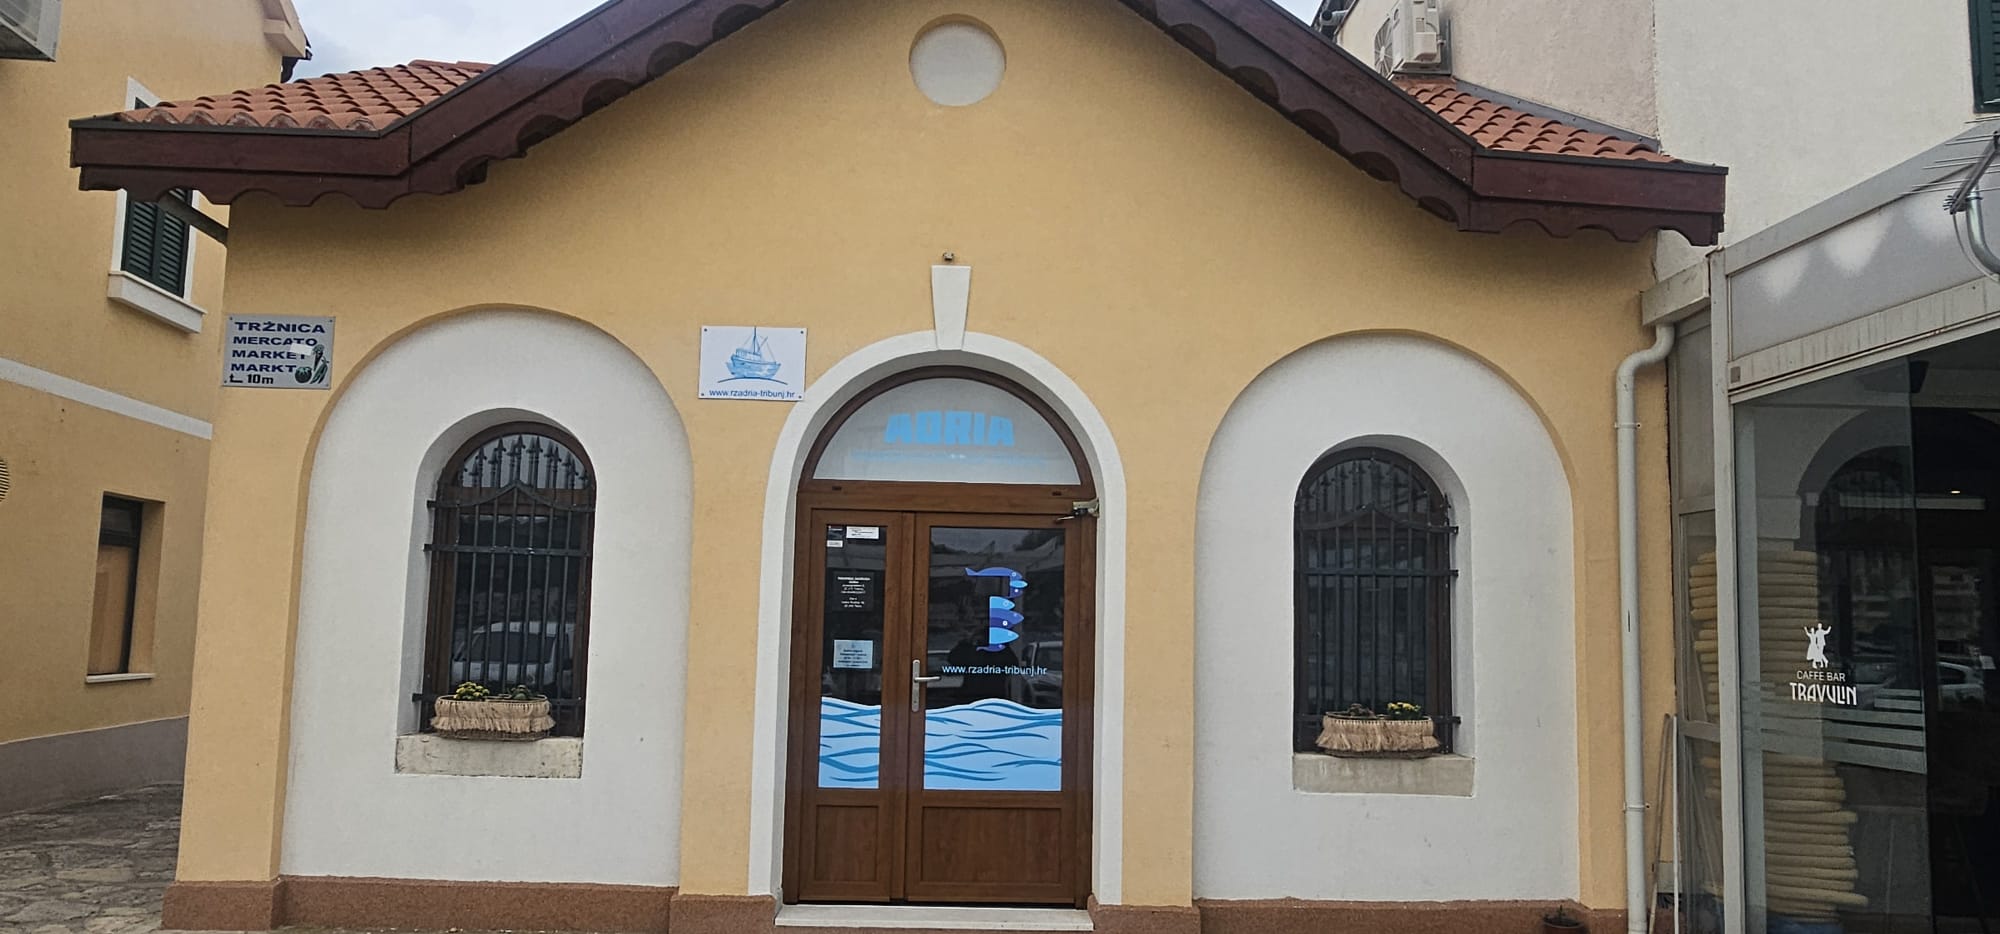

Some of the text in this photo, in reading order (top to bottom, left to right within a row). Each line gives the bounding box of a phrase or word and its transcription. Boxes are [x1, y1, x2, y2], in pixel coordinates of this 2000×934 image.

[234, 321, 325, 333] TRŽNICA
[232, 336, 318, 347] MERCATO
[230, 363, 297, 373] MARKT
[709, 389, 795, 399] www.rzadria-tribunj.hr
[942, 664, 1047, 676] www.rzadria-tribunj.hr
[1796, 671, 1846, 682] CAFFE BAR
[1789, 683, 1857, 705] TRAVULIN
